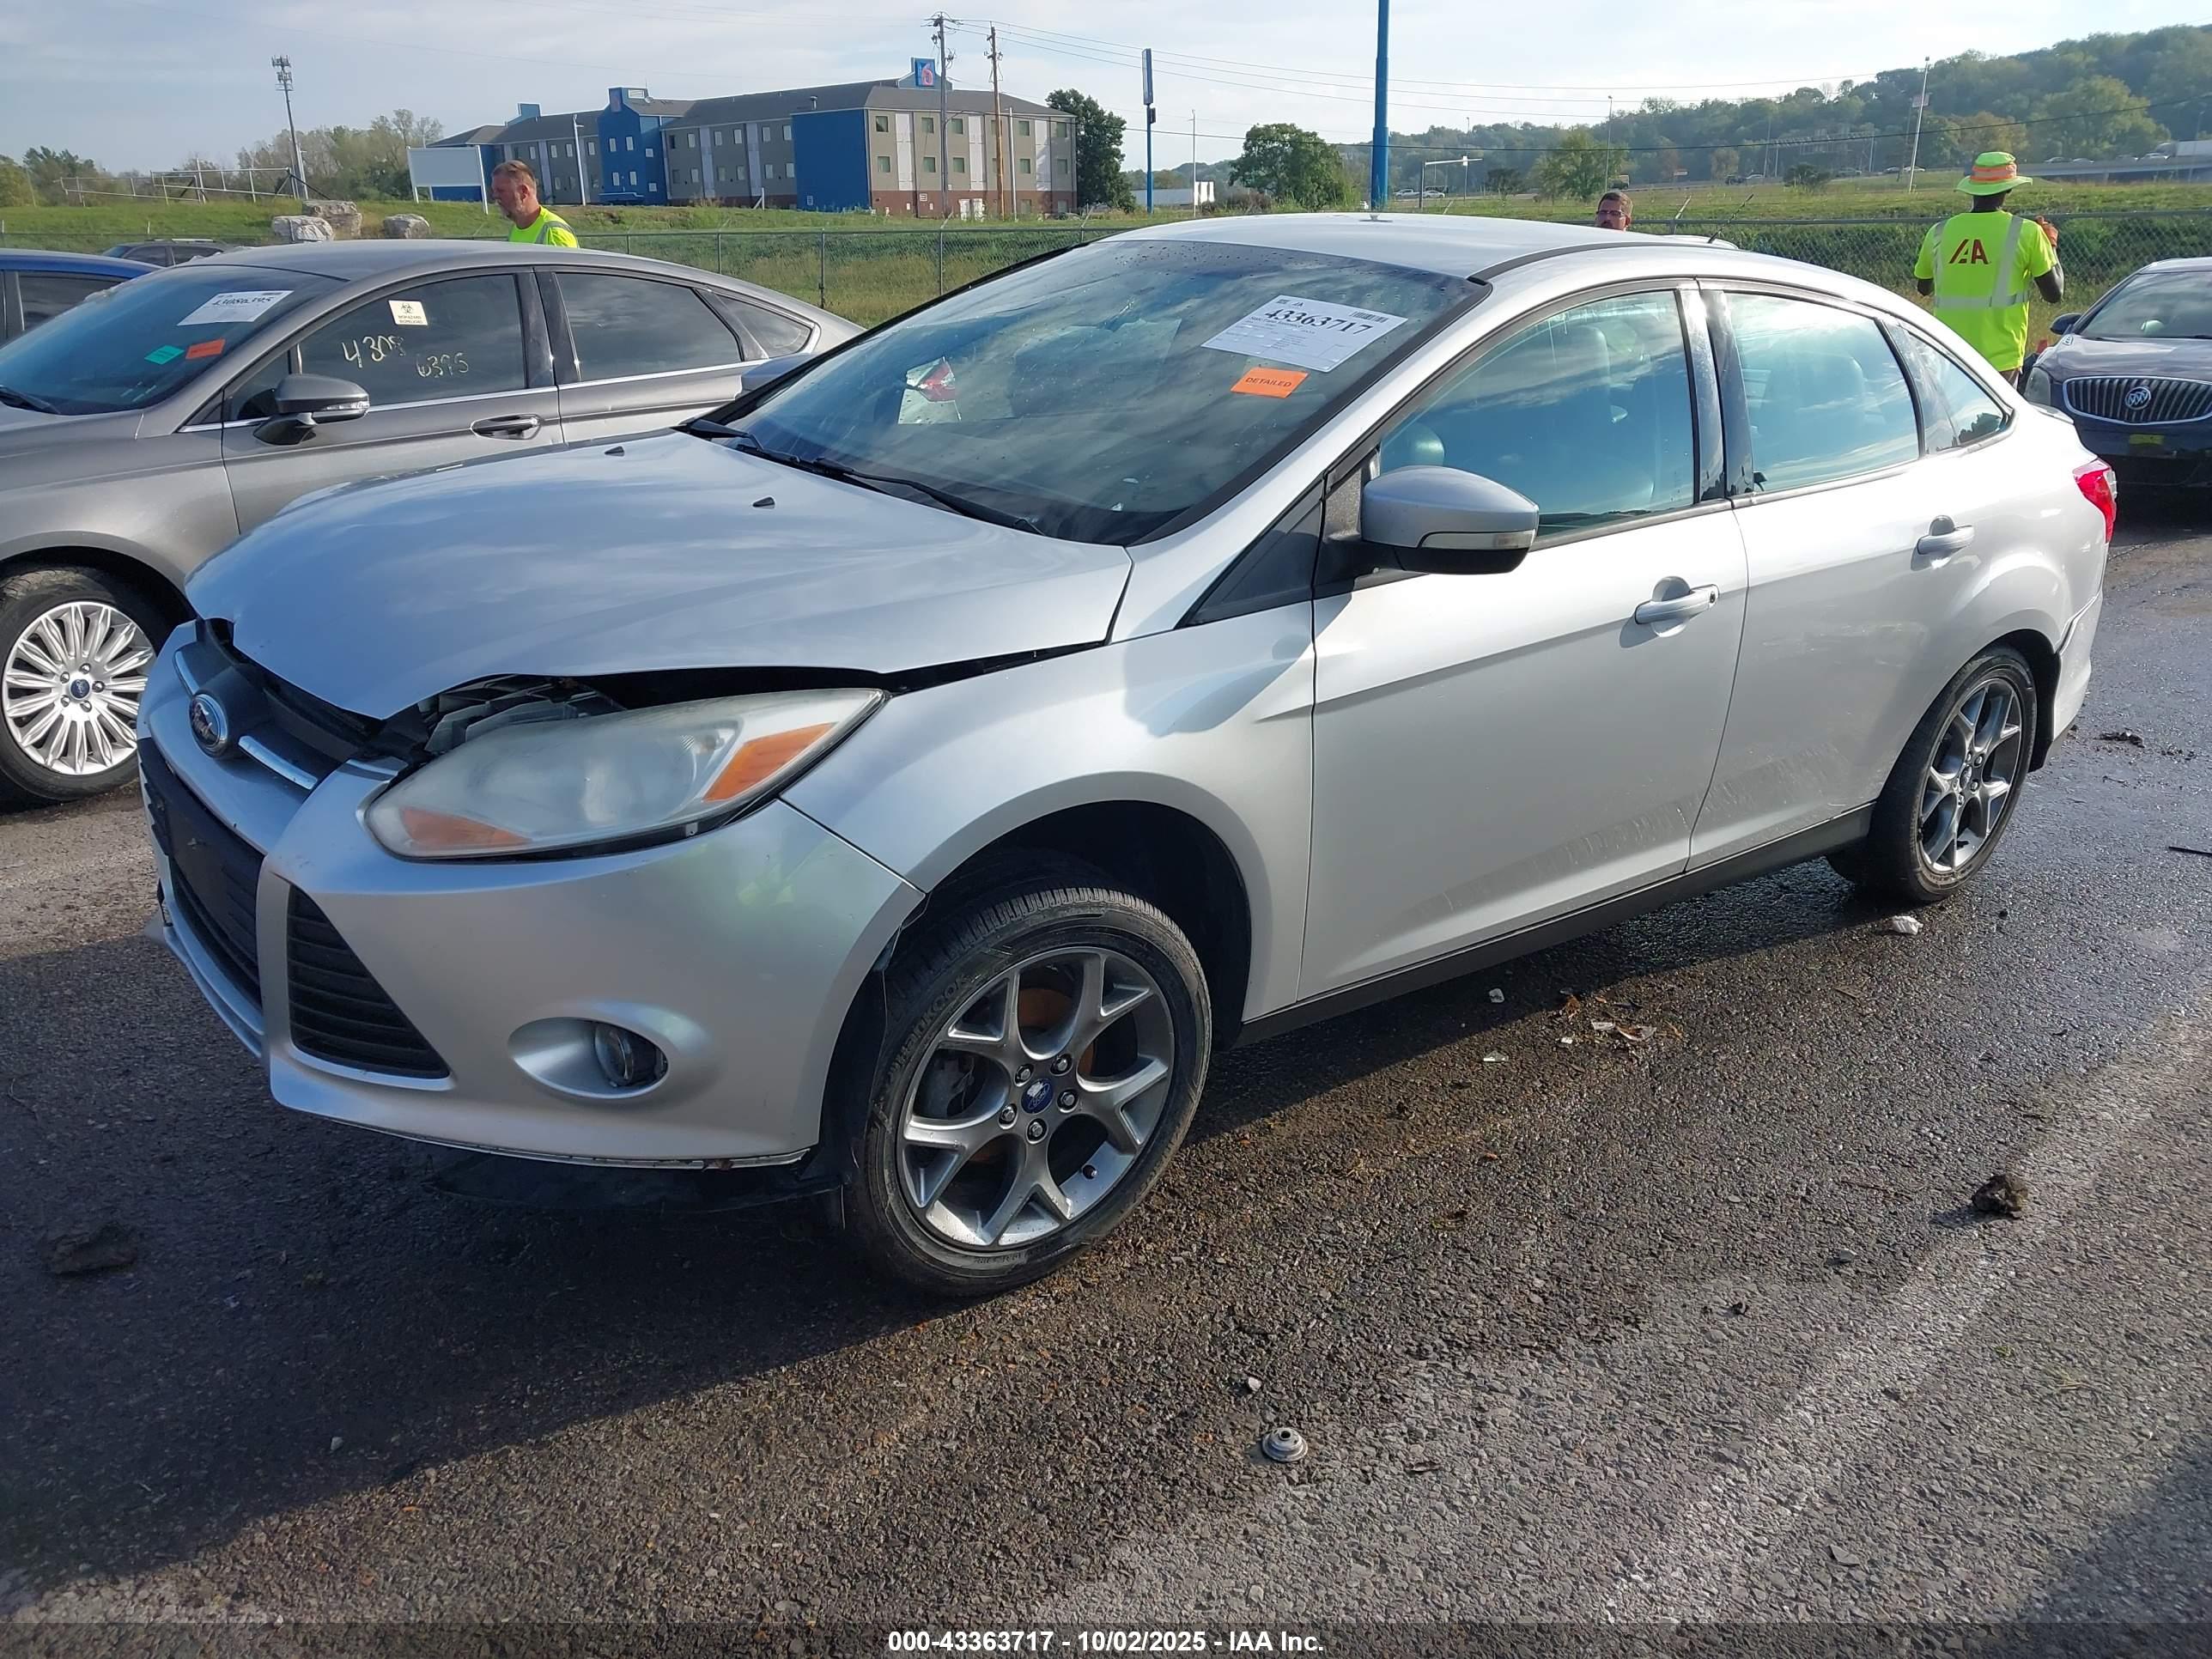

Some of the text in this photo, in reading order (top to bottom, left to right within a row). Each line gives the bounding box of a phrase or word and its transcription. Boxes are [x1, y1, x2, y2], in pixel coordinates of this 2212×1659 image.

[921, 63, 933, 86] 6
[1264, 308, 1373, 335] 43363717
[1245, 376, 1292, 387] DETAILED
